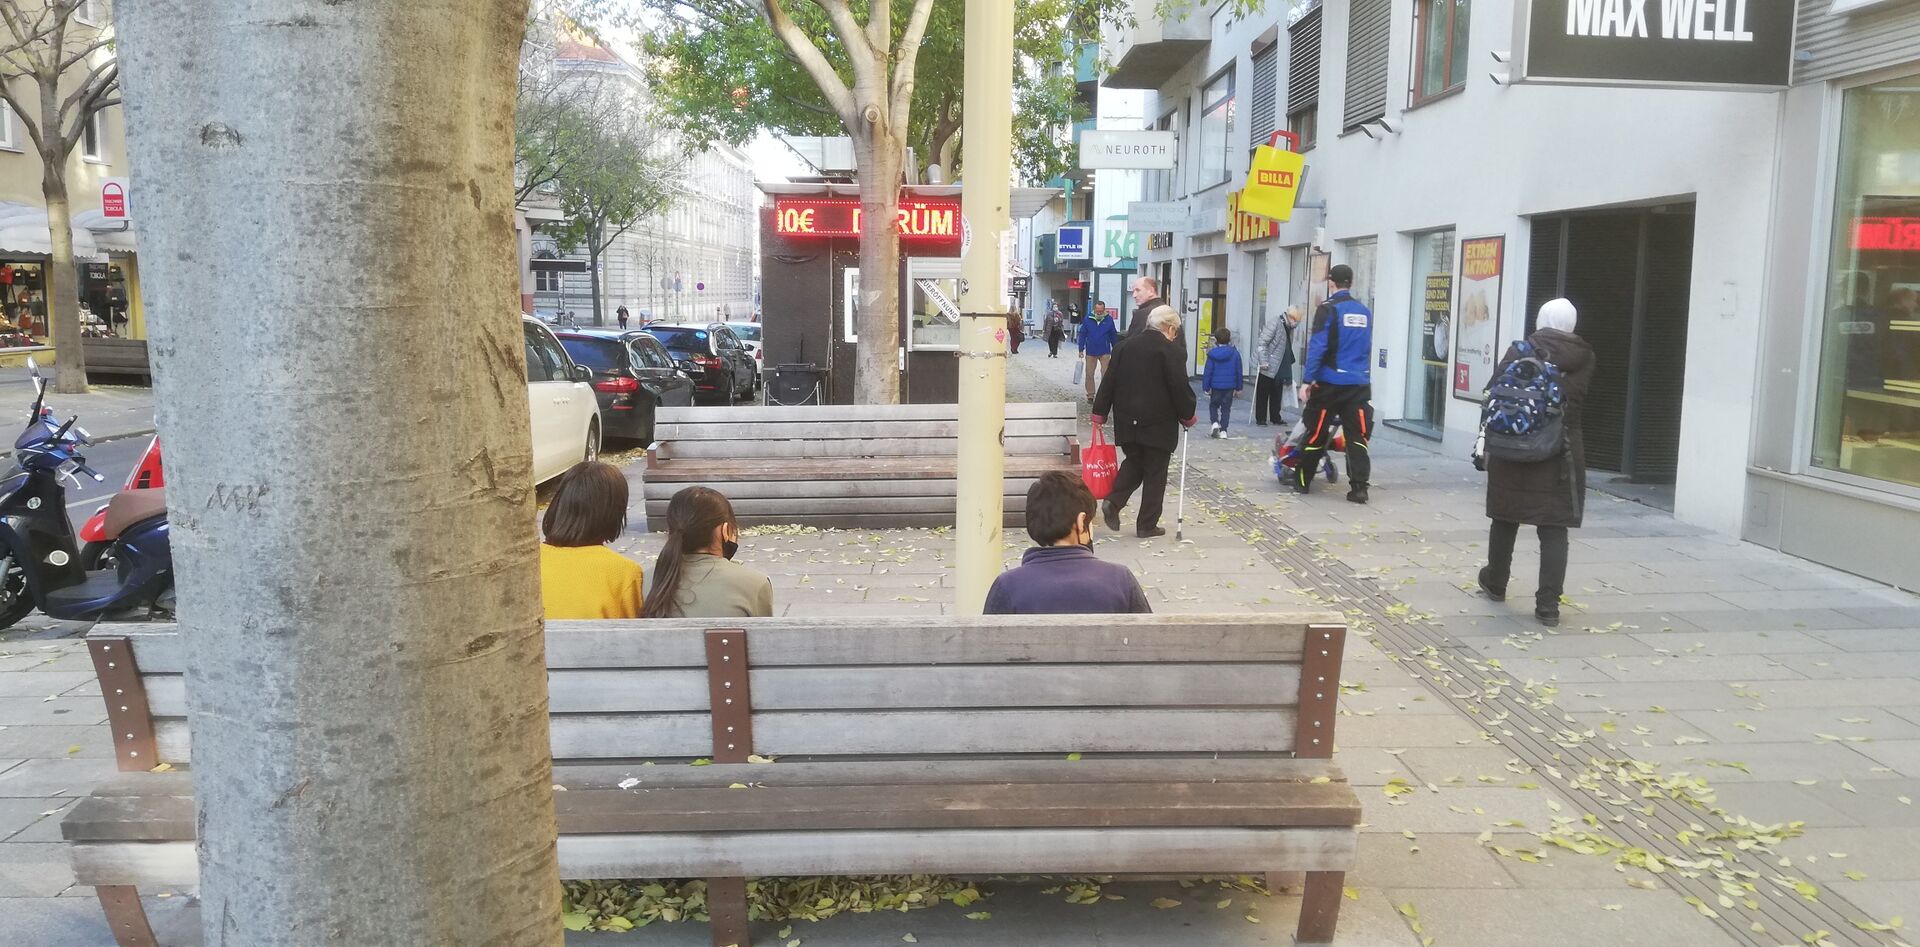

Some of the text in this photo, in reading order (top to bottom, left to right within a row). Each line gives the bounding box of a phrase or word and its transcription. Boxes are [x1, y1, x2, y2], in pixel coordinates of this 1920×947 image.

[1566, 0, 1754, 42] MAX WELL
[1105, 145, 1167, 155] NEUROTH
[1259, 172, 1291, 186] BILLA
[1466, 242, 1498, 259] EXTREM
[1464, 260, 1496, 275] AKTION
[919, 279, 959, 320] EUERÖFFNUNG
